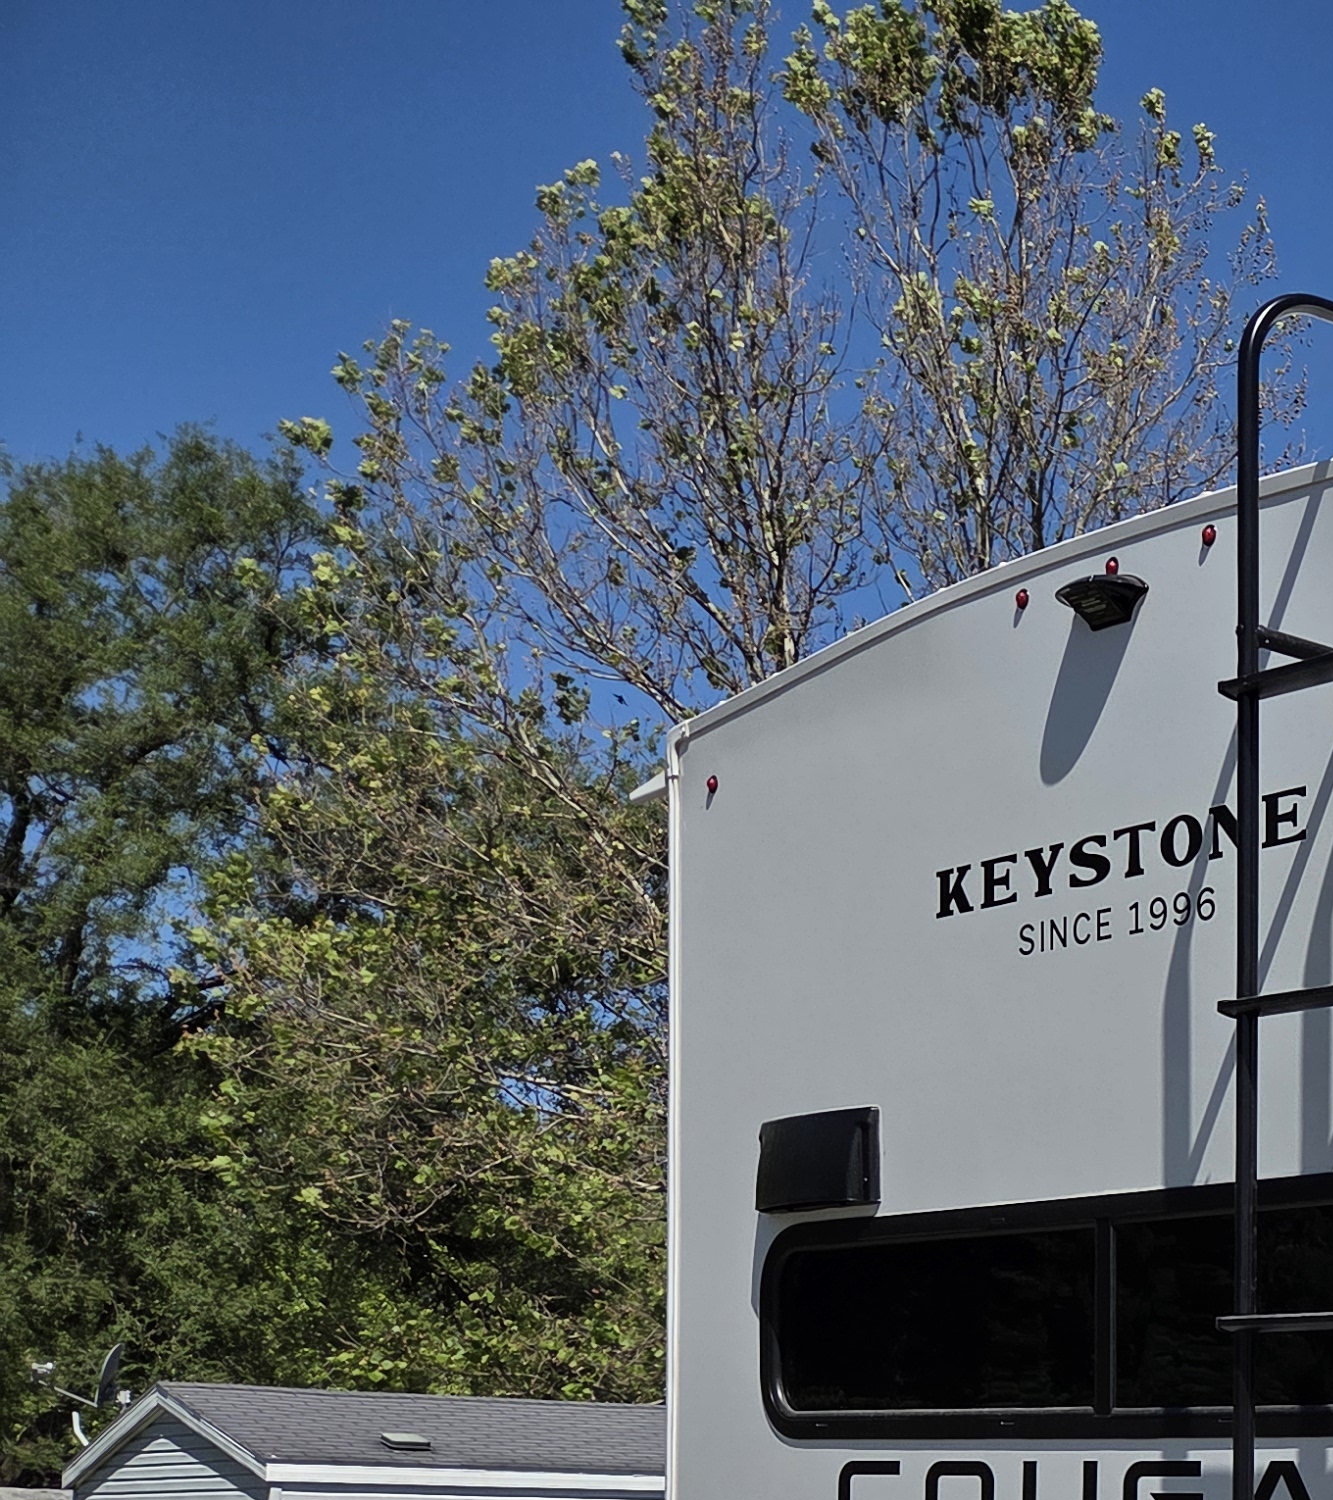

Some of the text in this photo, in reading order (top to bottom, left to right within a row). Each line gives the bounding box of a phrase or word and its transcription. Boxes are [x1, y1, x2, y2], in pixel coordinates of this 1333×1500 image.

[936, 786, 1307, 919] KEYSTONE
[1018, 886, 1216, 956] SINCE 1996
